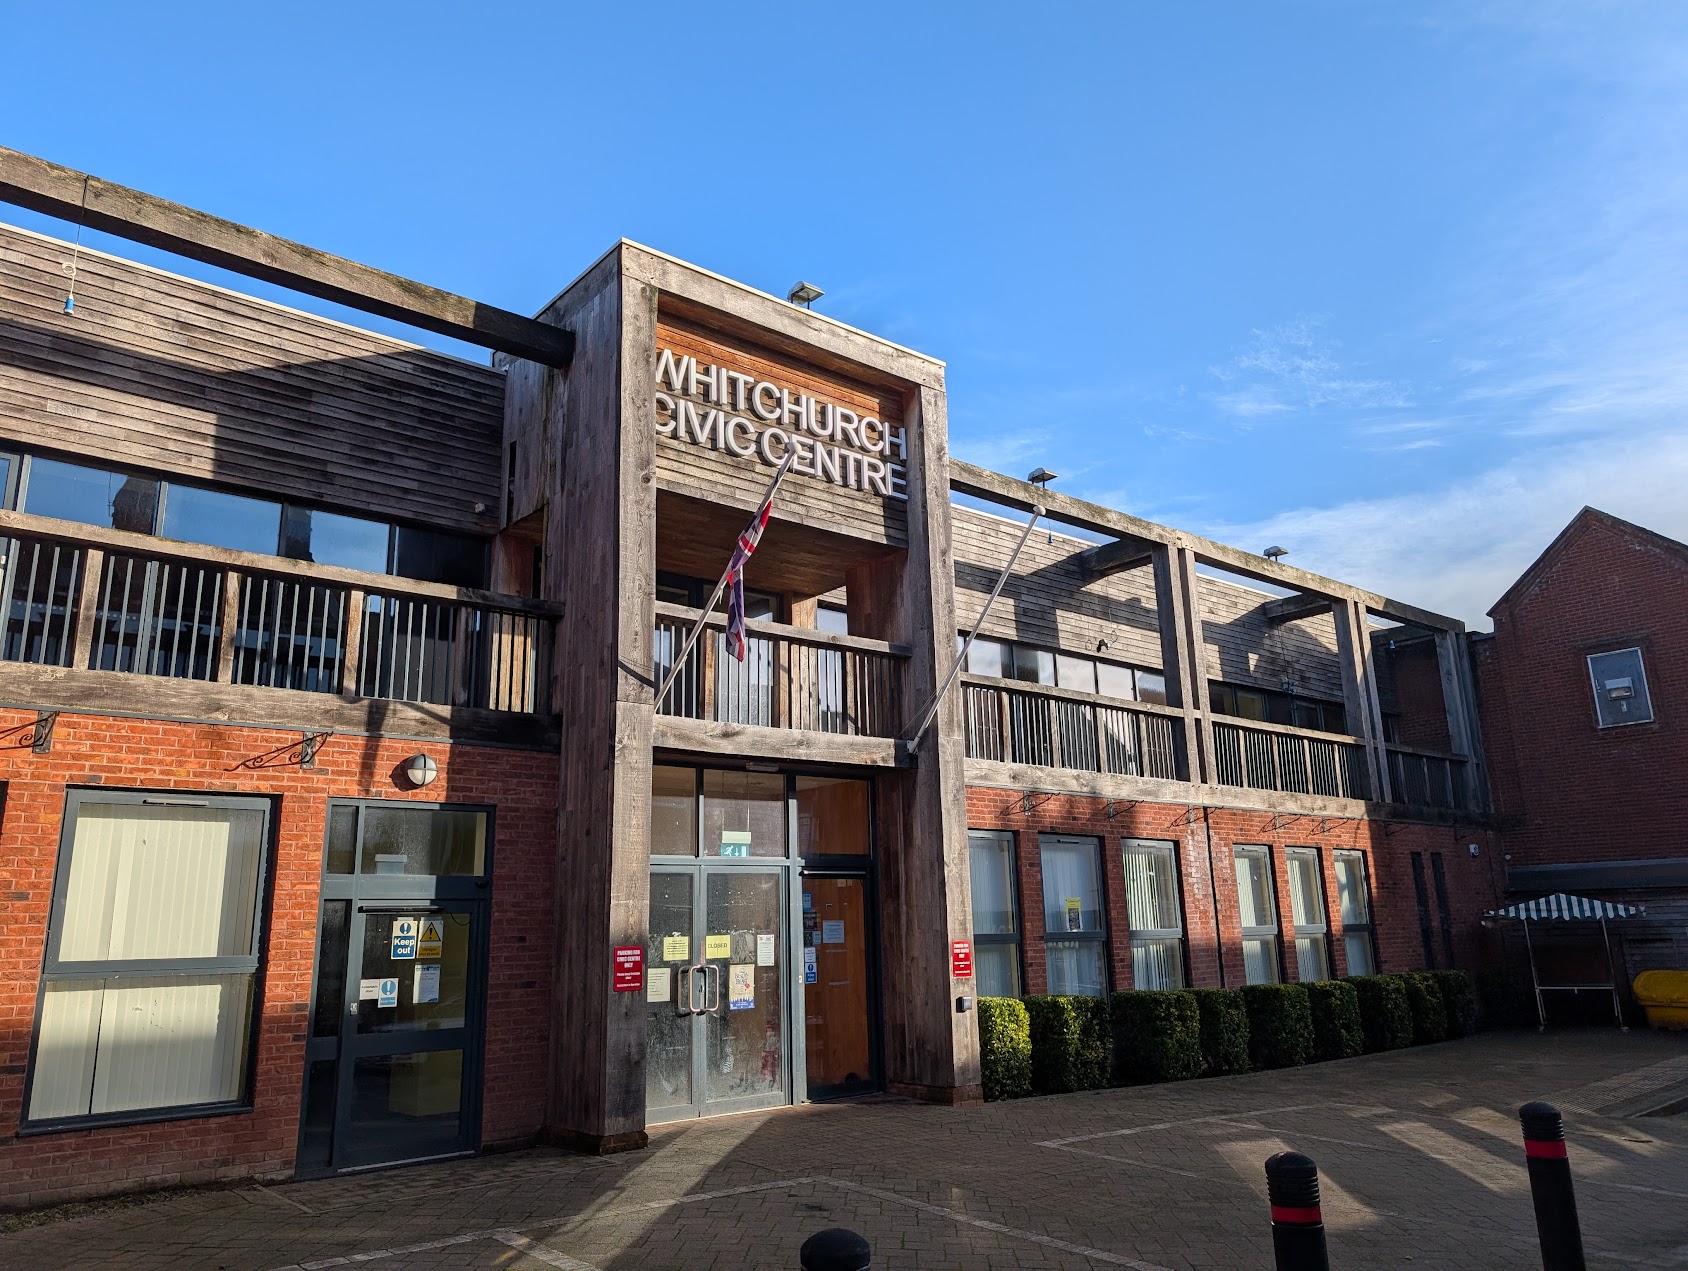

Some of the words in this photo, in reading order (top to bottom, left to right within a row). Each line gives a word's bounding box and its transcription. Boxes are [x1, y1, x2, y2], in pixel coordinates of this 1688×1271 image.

[656, 348, 907, 460] WHITCHURCH
[656, 392, 757, 457] CIVIC
[760, 427, 909, 500] CENTRE
[394, 938, 414, 947] Keep
[397, 946, 411, 954] out
